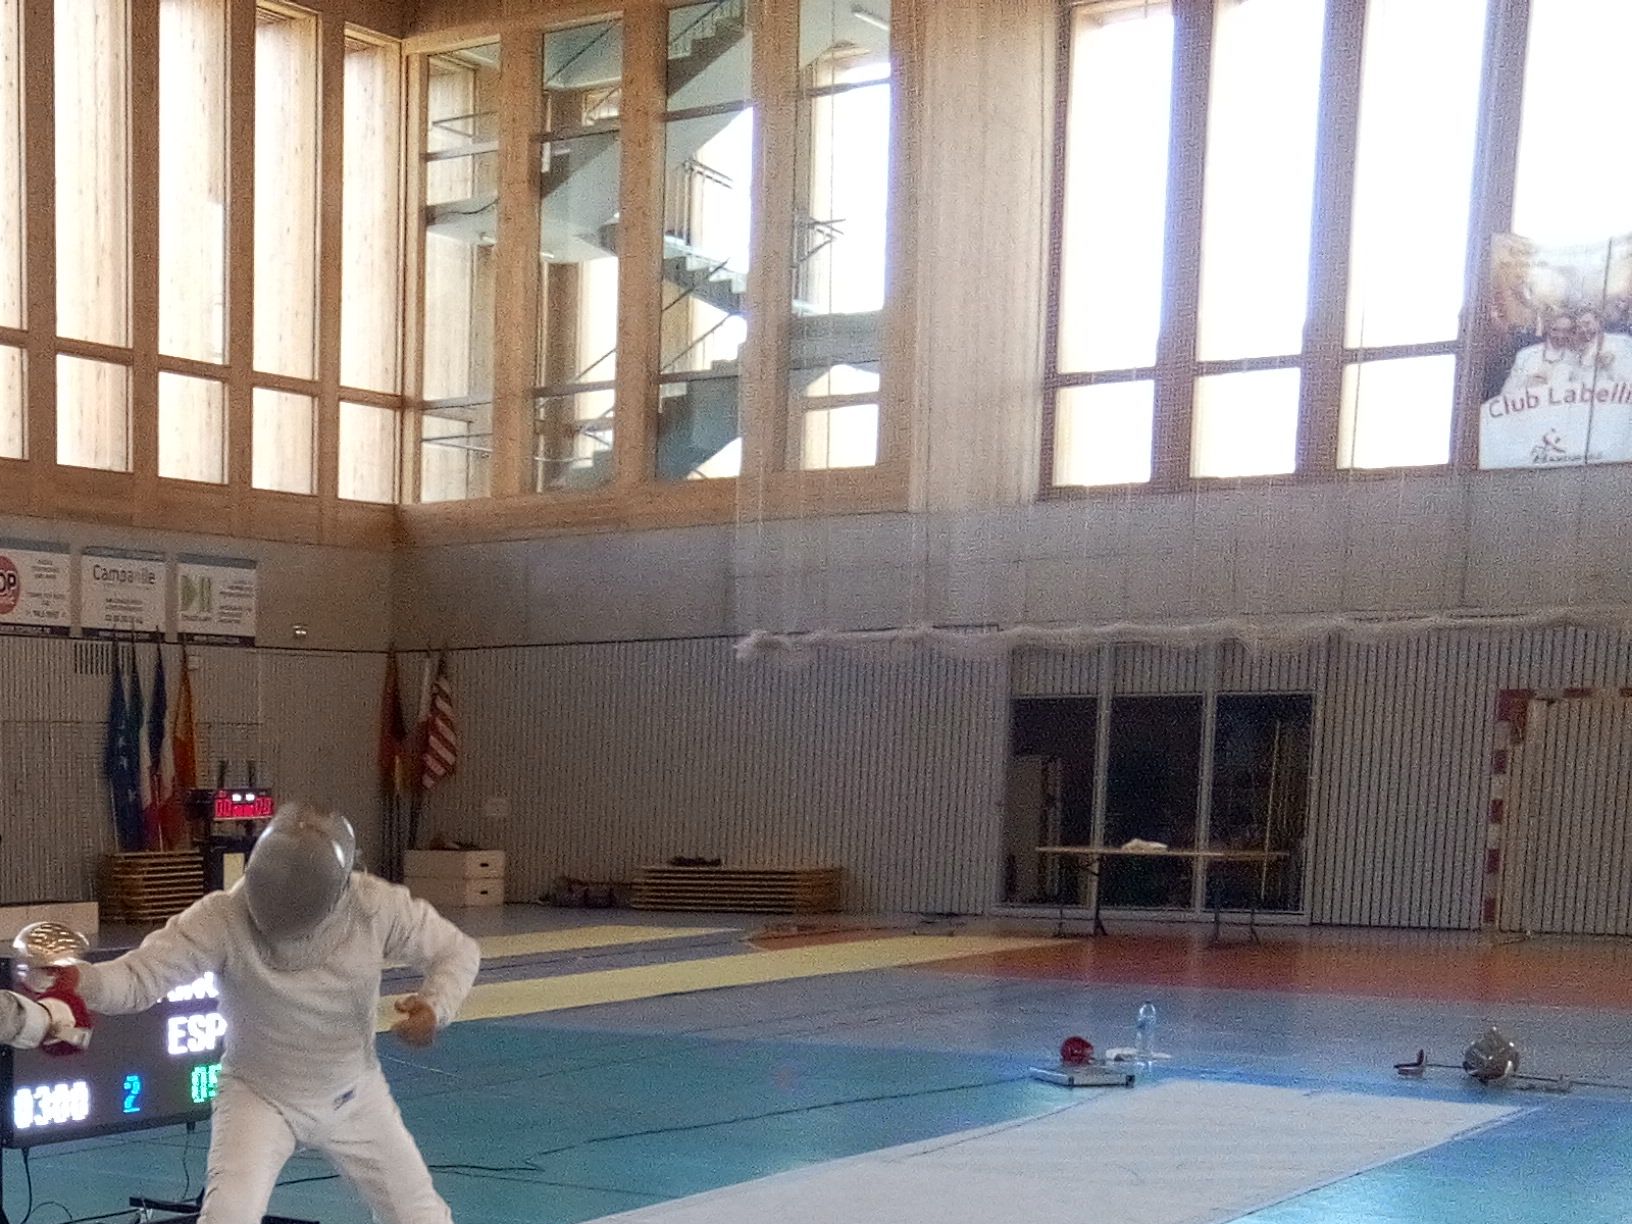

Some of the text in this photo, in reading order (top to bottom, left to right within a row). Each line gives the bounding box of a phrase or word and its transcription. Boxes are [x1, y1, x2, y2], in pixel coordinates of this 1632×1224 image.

[1489, 385, 1539, 418] Club
[168, 1012, 228, 1055] ESP
[123, 1074, 143, 1114] 2
